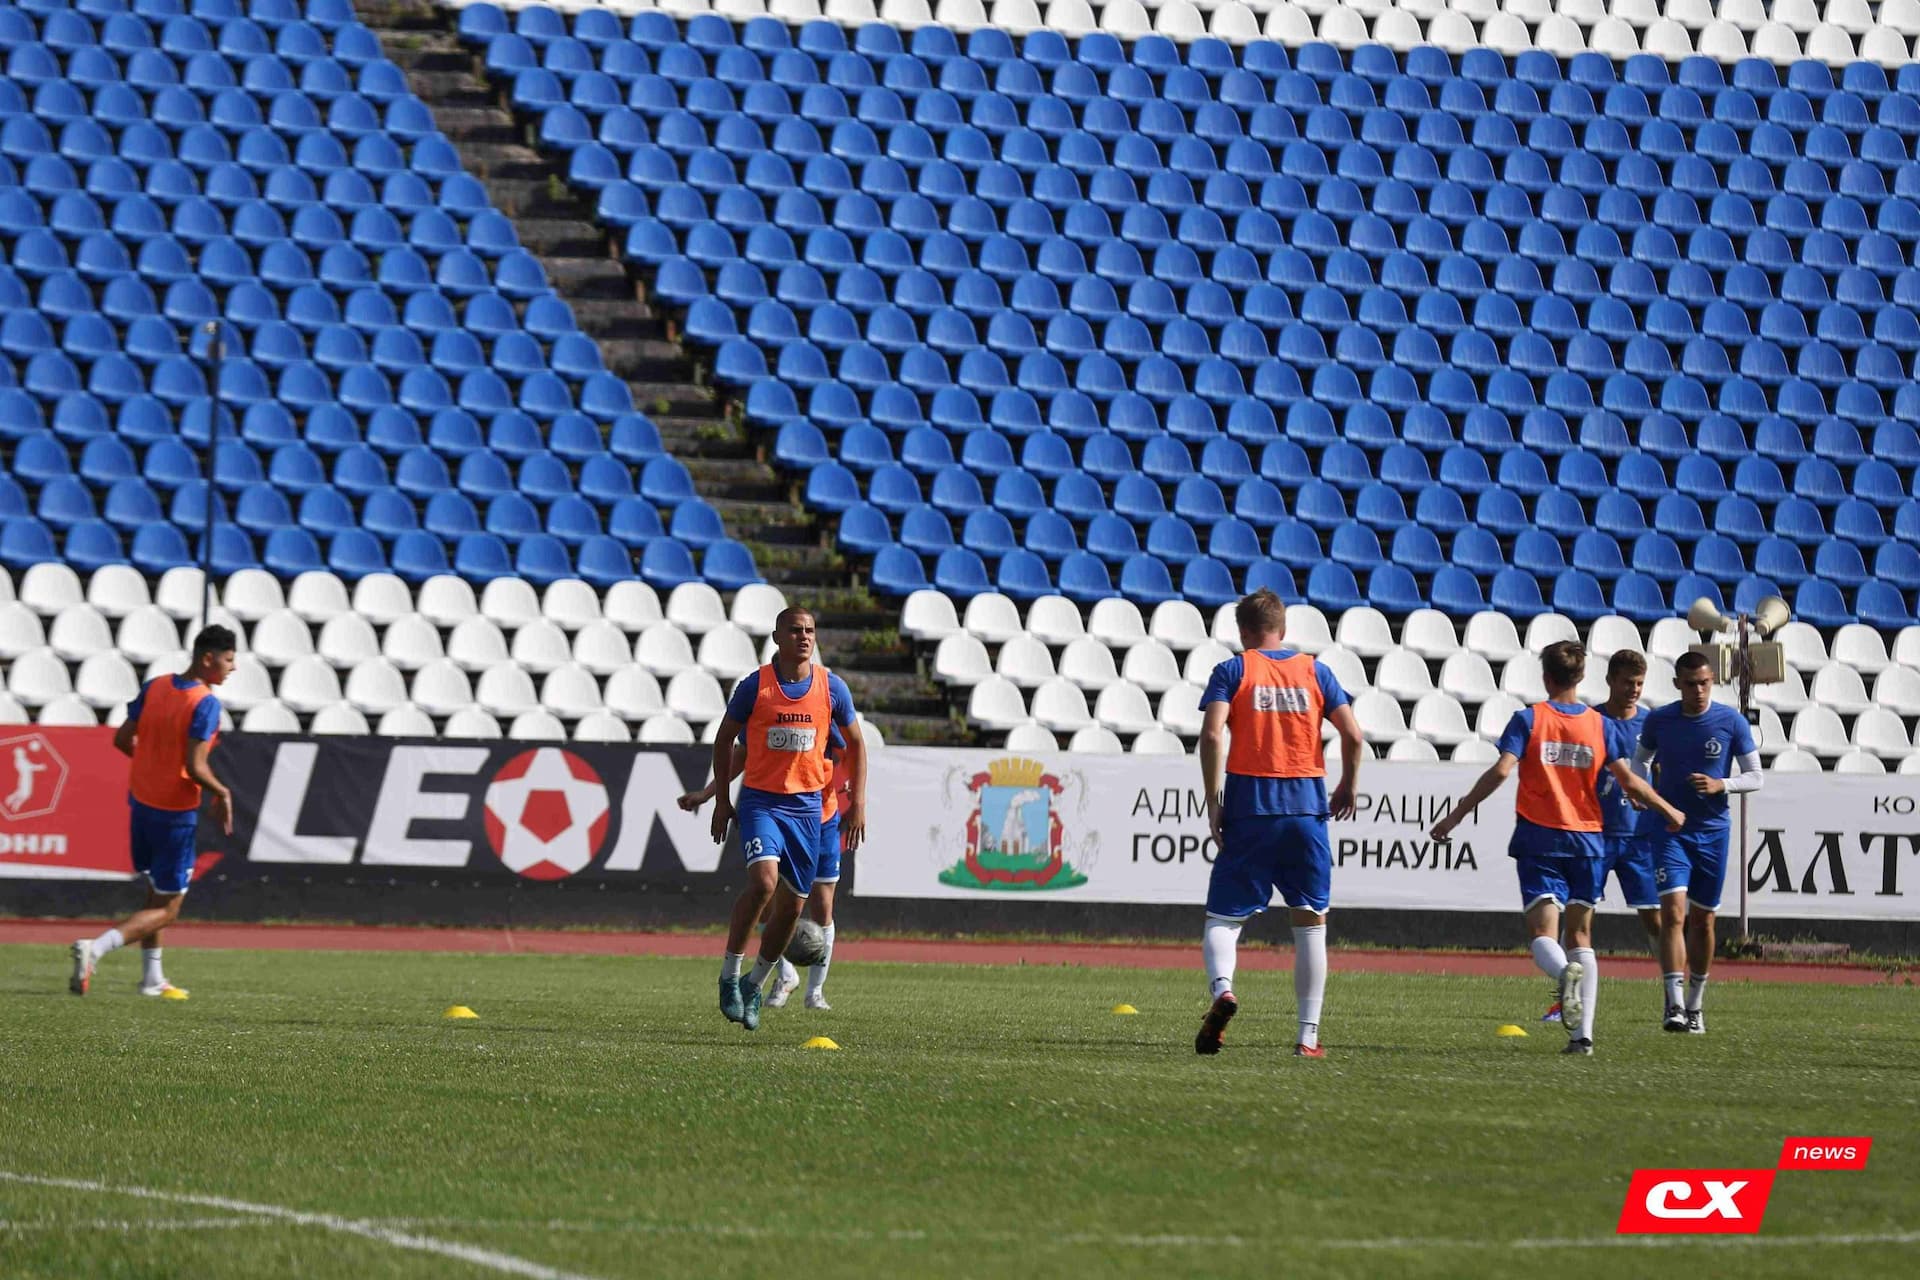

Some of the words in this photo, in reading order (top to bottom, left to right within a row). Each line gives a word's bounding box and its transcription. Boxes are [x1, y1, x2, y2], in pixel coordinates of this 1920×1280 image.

[247, 741, 746, 881] LEON
[745, 837, 763, 859] 23
[1331, 838, 1478, 870] РНАУЛА
